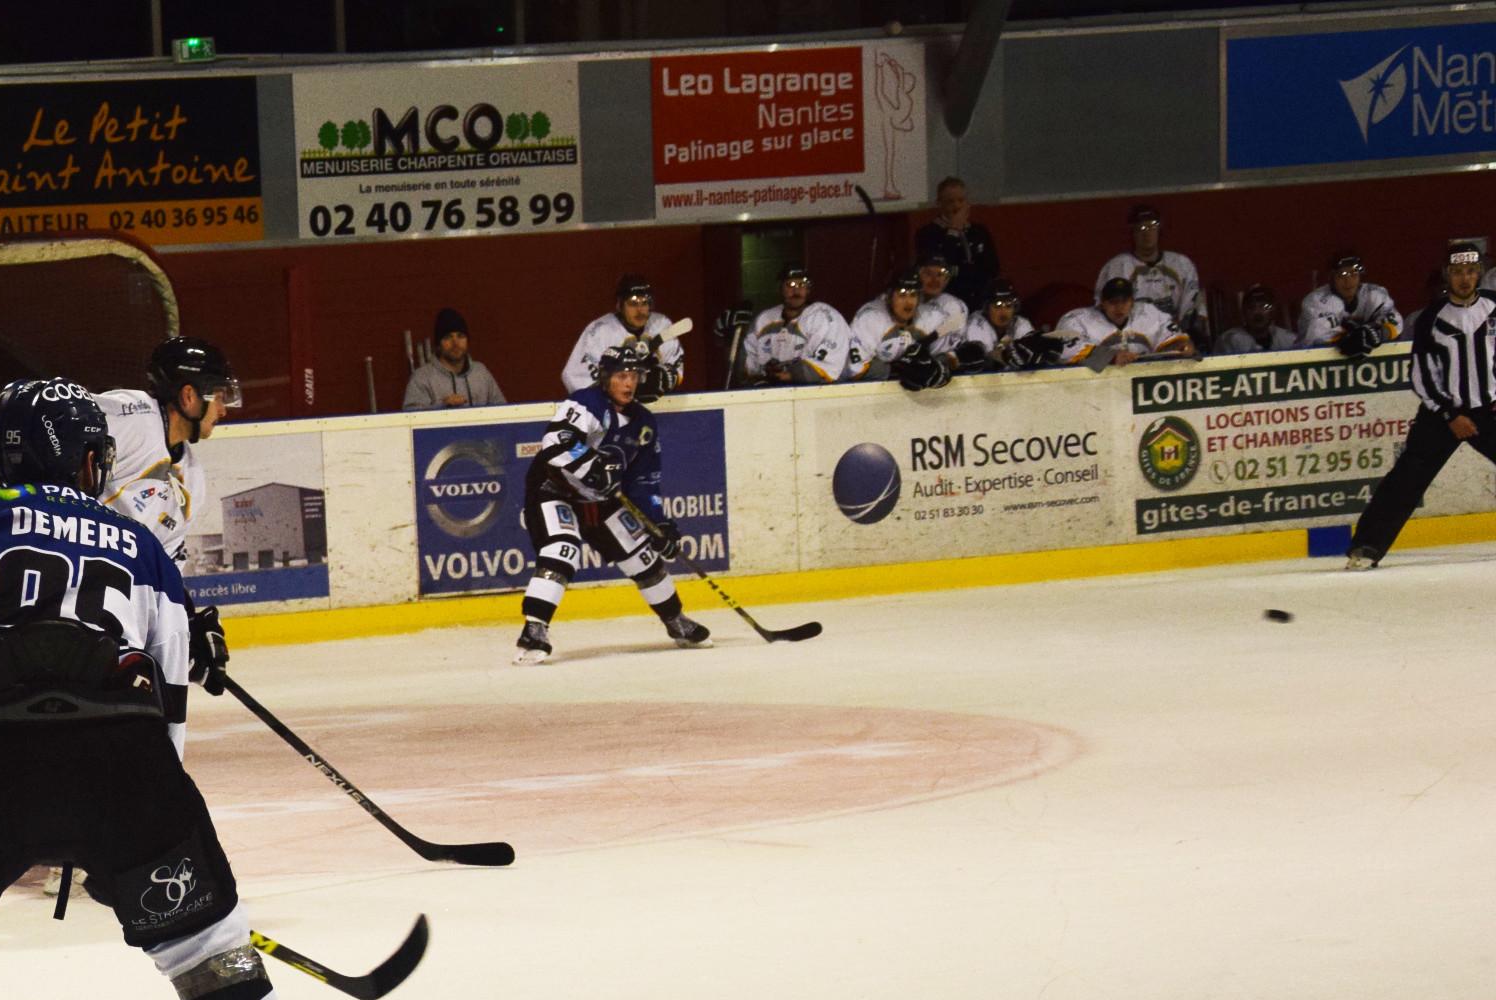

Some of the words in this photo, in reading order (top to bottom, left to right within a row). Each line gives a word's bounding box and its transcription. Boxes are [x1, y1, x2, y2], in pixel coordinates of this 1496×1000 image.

[662, 67, 713, 96] Leo
[724, 67, 854, 99] Lagrange
[23, 107, 77, 152] Le
[89, 101, 188, 144] Petit
[372, 103, 504, 155] MCO
[758, 100, 854, 129] Nantes
[664, 138, 754, 165] Patinage
[761, 133, 794, 151] sur
[801, 126, 854, 150] glace
[94, 149, 255, 189] Antoine
[303, 155, 394, 176] MENUISERIE
[397, 151, 486, 171] CHARPENTE
[489, 148, 576, 167] ORVALTAISE
[359, 182, 372, 194] La
[374, 179, 432, 194] menuiserie
[434, 181, 447, 191] en
[450, 177, 477, 189] toute
[479, 174, 521, 188] sérénité
[108, 210, 136, 231] 02
[140, 208, 167, 228] 40
[173, 207, 197, 227] 36
[203, 206, 228, 225] 95
[233, 204, 260, 224] 46
[309, 203, 356, 237] 02
[365, 200, 412, 233] 40
[421, 197, 465, 230] 76
[475, 195, 521, 228] 58
[529, 191, 575, 225] 99
[566, 407, 582, 424] 87
[1206, 405, 1310, 431] LOCATIONS
[1314, 399, 1366, 420] GÎTES
[5, 429, 22, 445] 95
[911, 433, 965, 472] RSM
[973, 430, 1098, 467] Secovec
[1207, 434, 1228, 454] ET
[1231, 425, 1335, 450] CHAMBRES
[1234, 458, 1260, 482] 02
[1266, 455, 1289, 479] 51
[1295, 452, 1321, 476] 72
[1325, 449, 1353, 473] 95
[1356, 446, 1384, 470] 65
[430, 481, 502, 498] VOLVO
[913, 478, 954, 498] Audit
[965, 471, 1034, 497] Expertise
[1044, 464, 1099, 486] Conseil
[914, 509, 927, 521] 02
[929, 508, 941, 520] 51
[956, 505, 970, 517] 30
[971, 504, 984, 516] 30
[11, 505, 138, 560] DEMERS
[559, 544, 577, 561] 87
[199, 584, 229, 597] accès
[231, 582, 257, 595] libre
[303, 753, 364, 803] NEXUS
